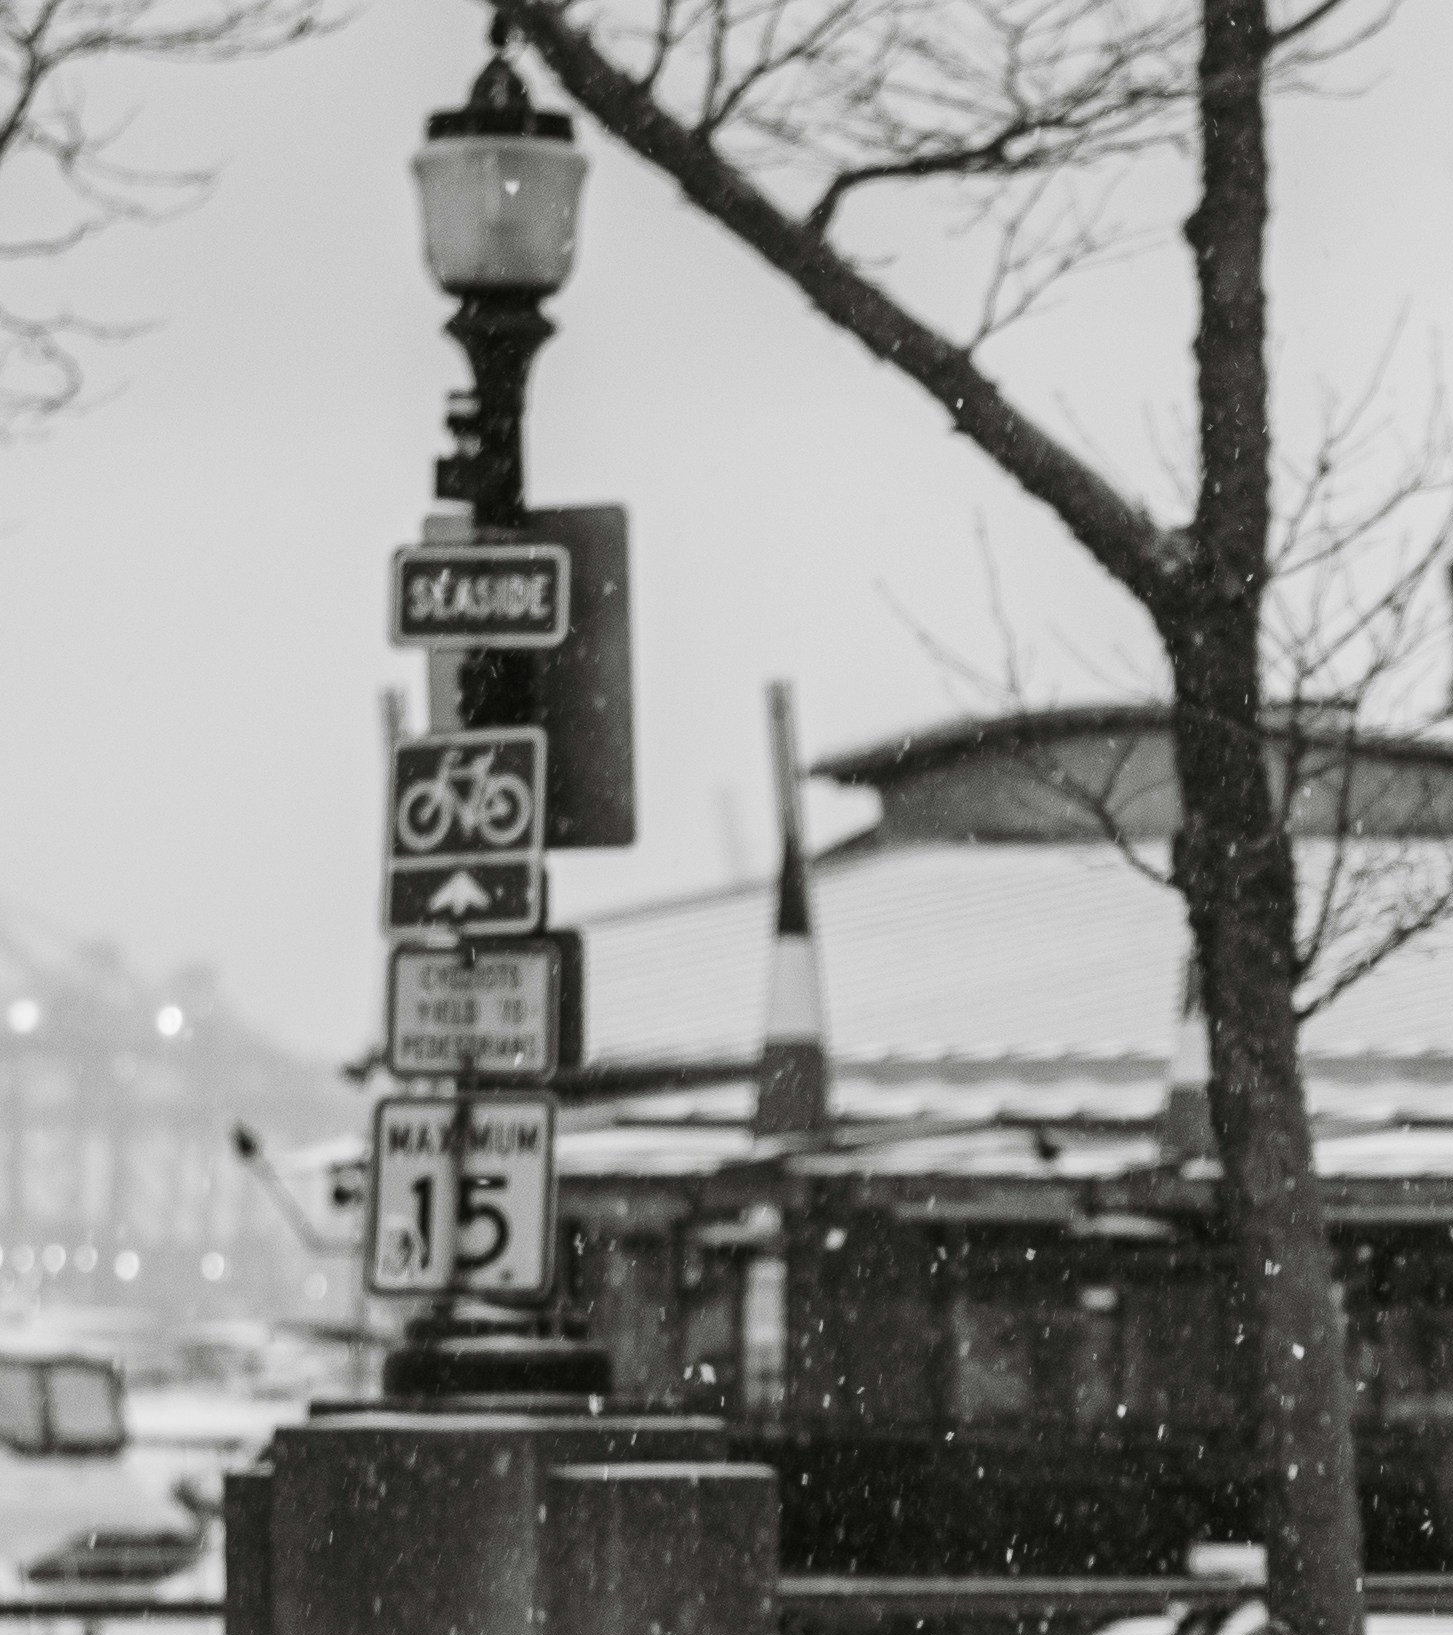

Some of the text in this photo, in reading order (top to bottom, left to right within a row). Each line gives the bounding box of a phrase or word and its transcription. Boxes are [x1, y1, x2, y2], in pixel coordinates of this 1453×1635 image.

[408, 572, 551, 620] SEASIDE
[388, 1121, 539, 1156] MAXMUM
[411, 1174, 510, 1271] 15
